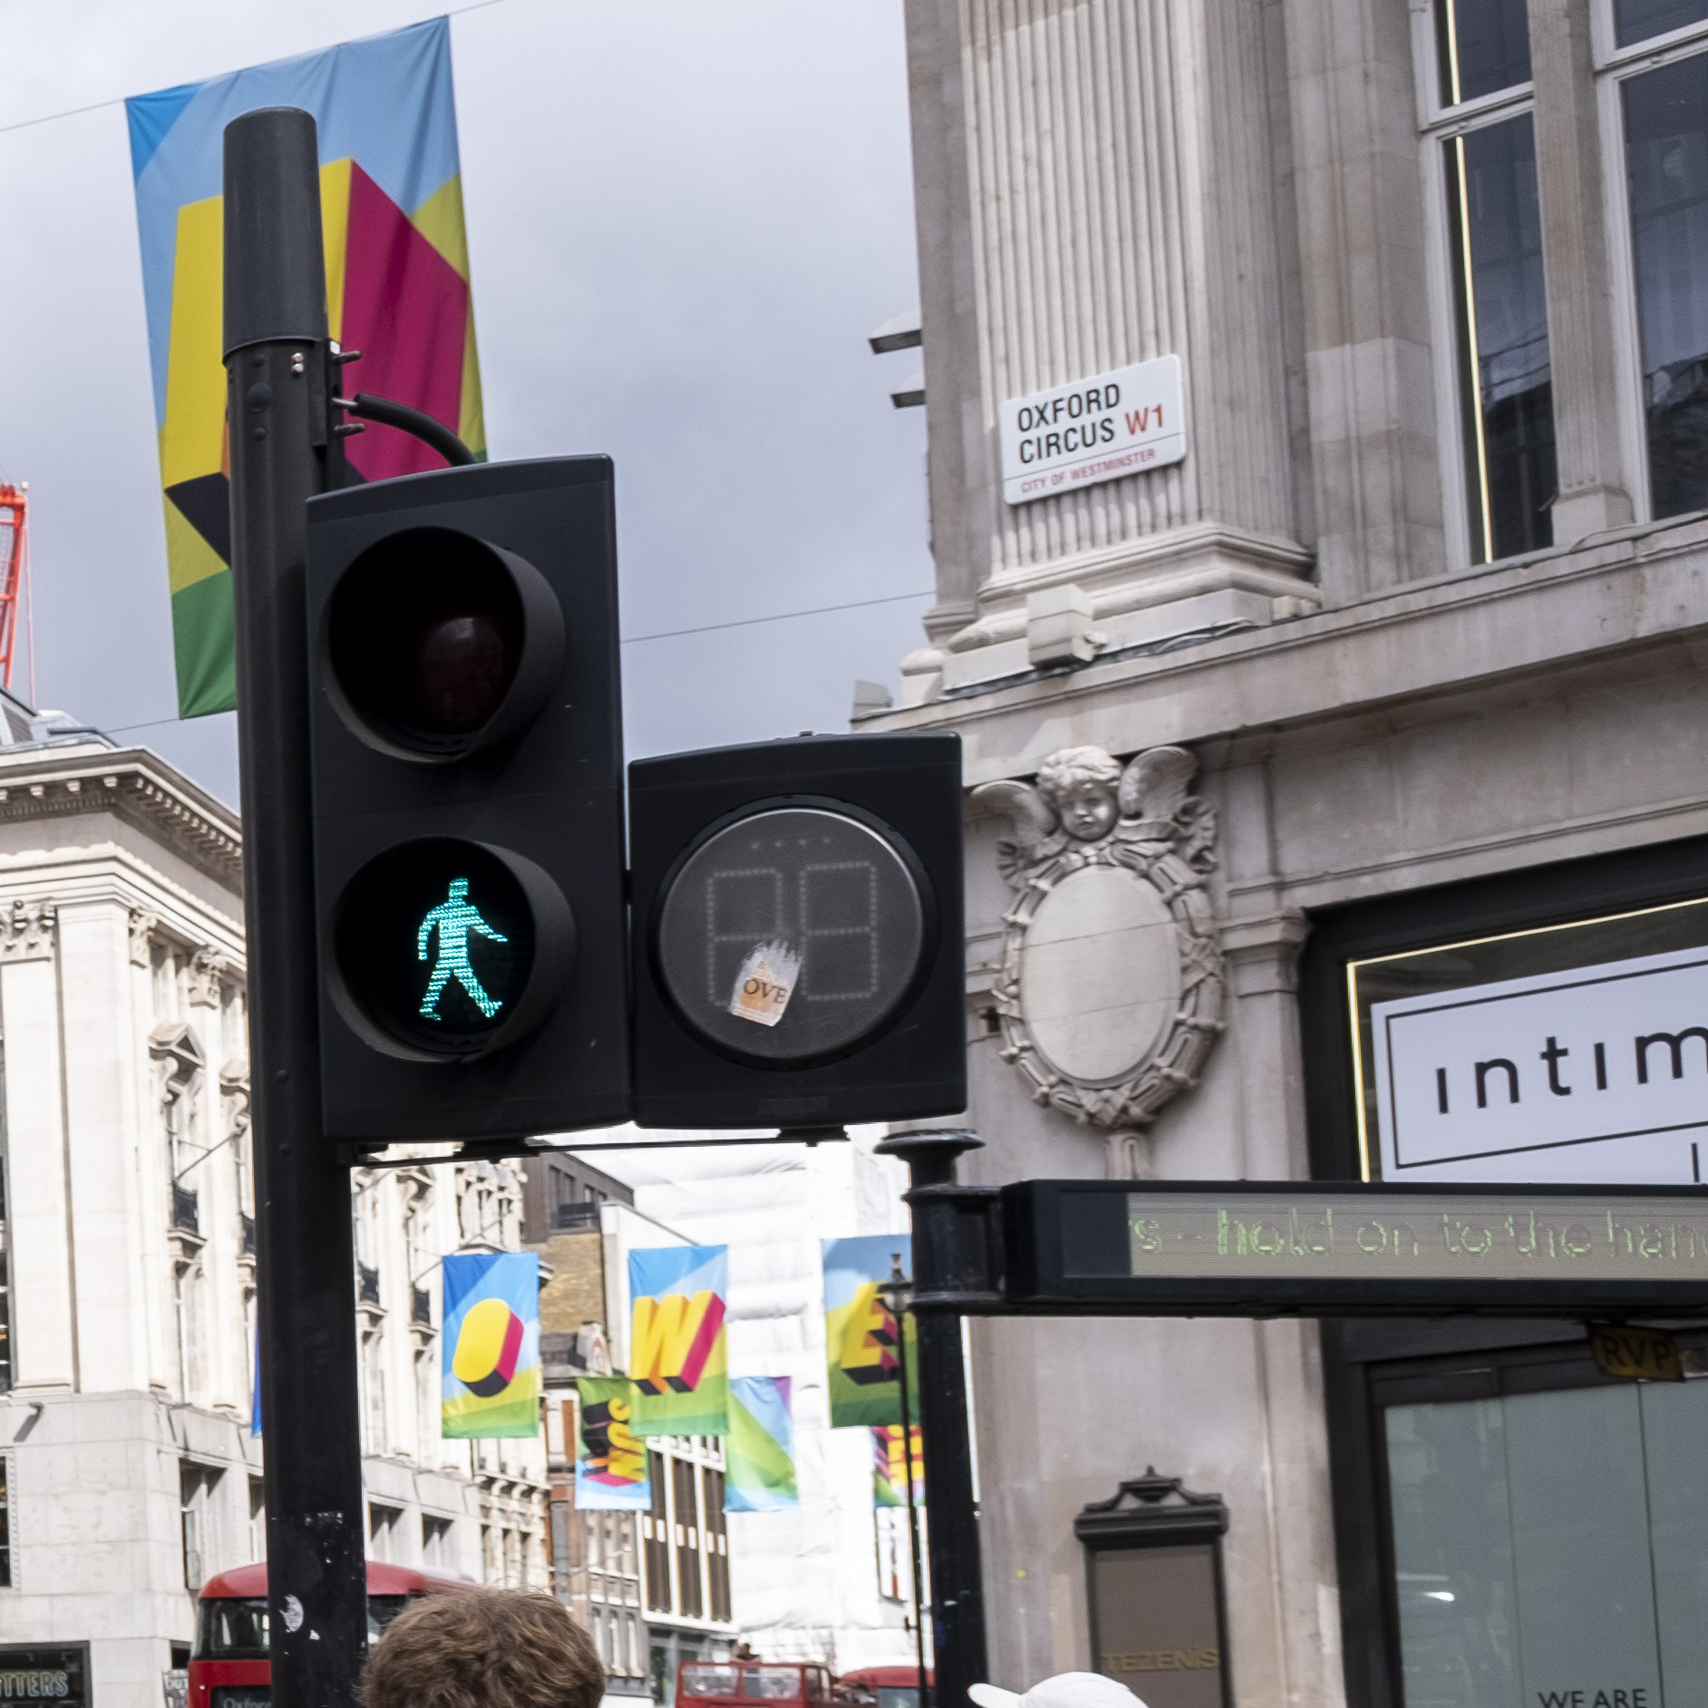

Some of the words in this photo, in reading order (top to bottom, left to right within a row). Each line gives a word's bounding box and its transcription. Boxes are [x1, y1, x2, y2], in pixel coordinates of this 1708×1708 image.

[1018, 383, 1120, 432] OXFORD
[1020, 418, 1115, 464] CIRCUS
[1126, 403, 1164, 435] W1
[1021, 476, 1048, 494] CITY
[1050, 471, 1066, 486] OF
[1070, 448, 1157, 481] WESTMINSTER
[1216, 1208, 1334, 1256] hold
[1355, 1219, 1418, 1257] on
[1442, 1213, 1493, 1256] to
[453, 1298, 525, 1398] O
[631, 1290, 727, 1396] W
[1602, 1334, 1672, 1371] RVP
[1100, 1648, 1220, 1674] TEZENIS
